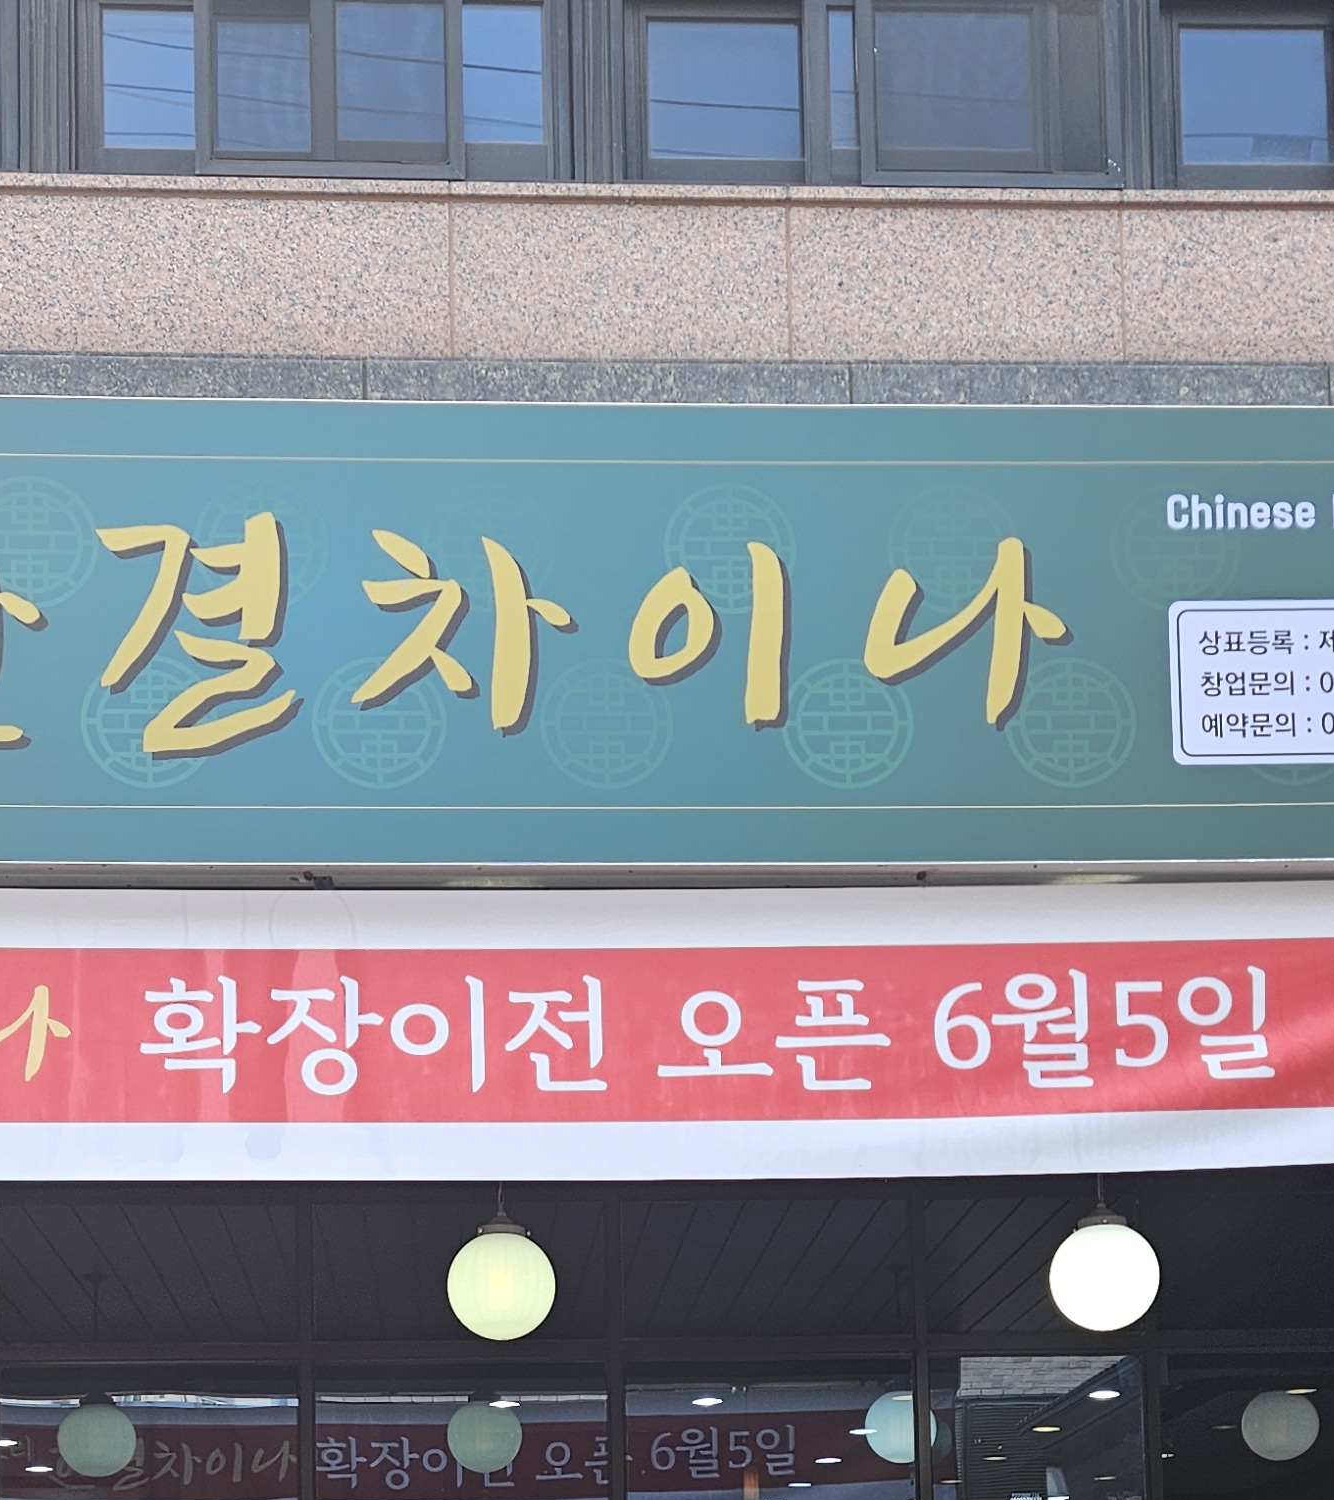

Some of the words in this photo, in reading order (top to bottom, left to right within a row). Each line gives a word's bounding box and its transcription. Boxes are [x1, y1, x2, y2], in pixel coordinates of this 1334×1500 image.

[1167, 494, 1316, 530] Chinese
[1198, 629, 1294, 655] 상표등록
[1200, 671, 1295, 697] 창업문의
[1202, 712, 1296, 738] 예약문의
[139, 971, 607, 1097] 확장이전
[655, 976, 892, 1092] 오픈
[934, 965, 1276, 1088] 6월5일
[650, 1424, 796, 1479] 6월5일
